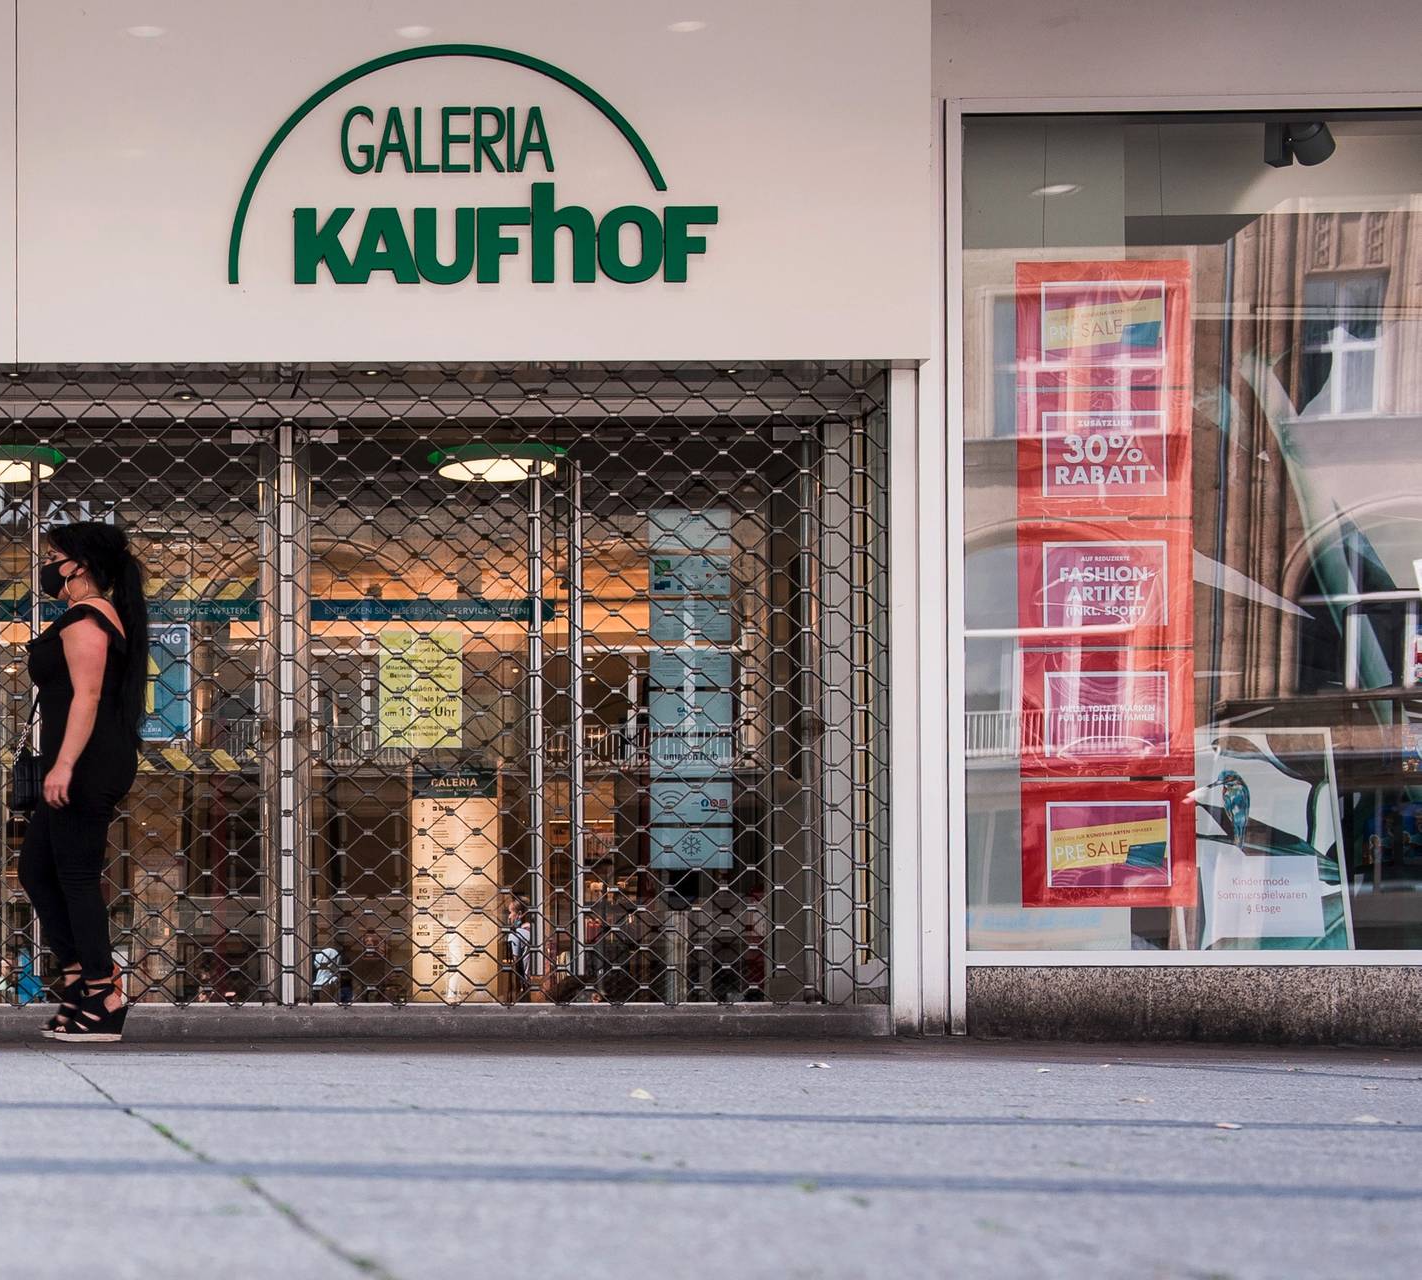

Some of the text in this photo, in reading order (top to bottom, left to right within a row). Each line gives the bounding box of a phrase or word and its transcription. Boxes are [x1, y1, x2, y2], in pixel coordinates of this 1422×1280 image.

[340, 105, 555, 175] GALERIA
[1077, 418, 1132, 427] ZUSÄTZLICH
[1062, 432, 1143, 464] 30%
[1067, 585, 1145, 601] ARTIKEL
[1066, 605, 1146, 618] (INKL. SPORT)
[435, 706, 457, 717] Uhr
[1121, 704, 1156, 712] MARKEN
[663, 752, 698, 761] amazon
[430, 777, 478, 787] GALERIA
[1055, 838, 1129, 862] PRESALE
[1232, 877, 1290, 886] Kindermode
[1217, 890, 1308, 901] Sommerspielwaren
